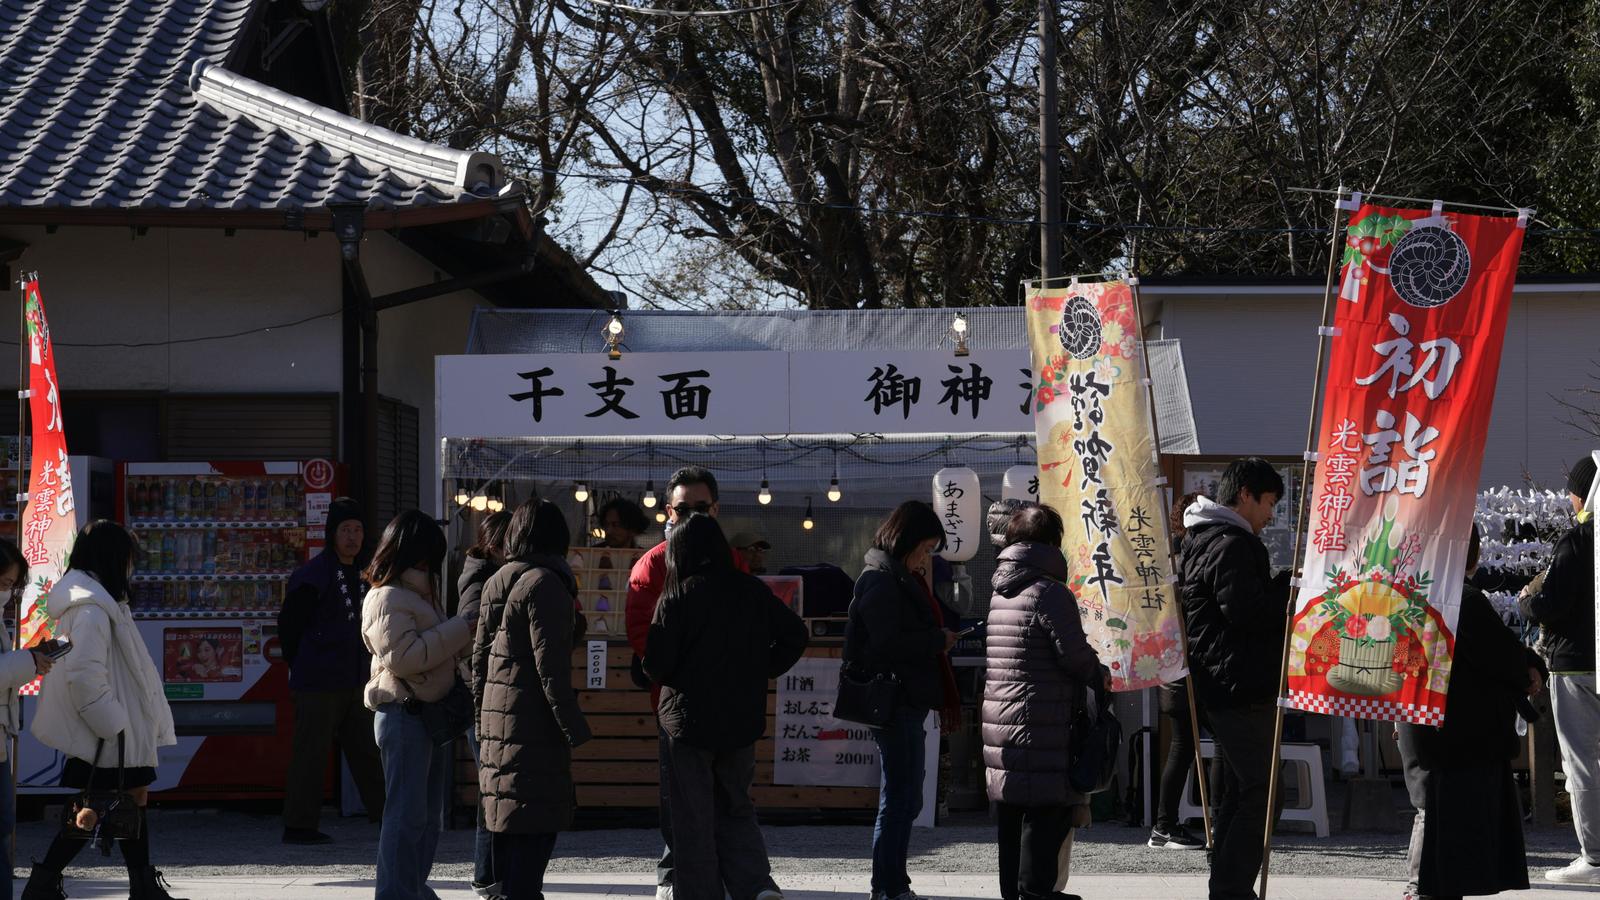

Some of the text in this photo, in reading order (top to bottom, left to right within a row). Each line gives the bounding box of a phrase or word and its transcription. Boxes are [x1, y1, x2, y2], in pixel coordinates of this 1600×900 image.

[508, 366, 712, 423] 干支面
[1355, 312, 1462, 499] 初詣
[25, 459, 58, 568] 光雲神社
[943, 480, 964, 554] あまざけ
[1313, 417, 1362, 554] 光雲神社
[783, 700, 829, 715] おしるこ
[785, 675, 815, 692] 甘酒
[781, 747, 874, 765] お茶 200円
